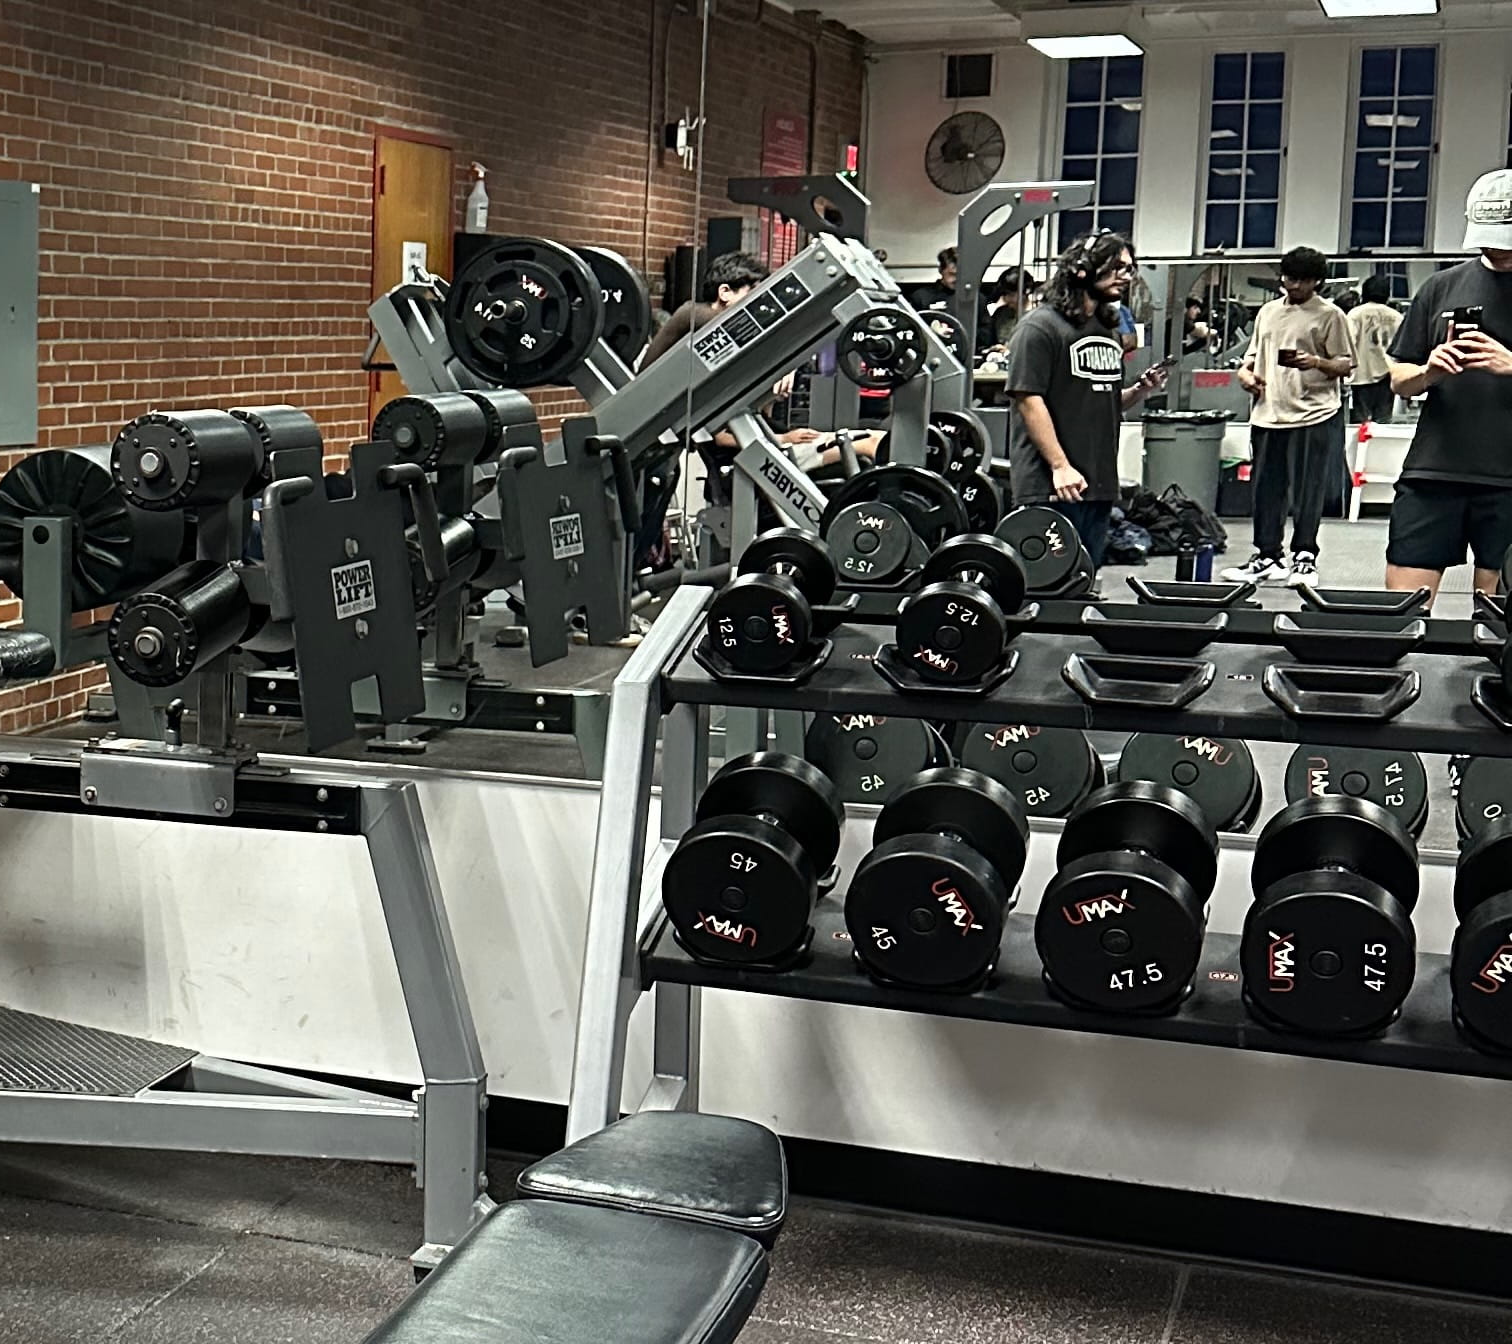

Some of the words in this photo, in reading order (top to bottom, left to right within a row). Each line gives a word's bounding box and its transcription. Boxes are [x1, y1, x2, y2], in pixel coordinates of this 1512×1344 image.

[333, 564, 371, 590] POWER
[336, 581, 373, 606] LIFT
[771, 605, 794, 645] UMAX
[944, 601, 979, 627] 12.5
[718, 616, 736, 648] 12.5
[913, 643, 959, 676] UMAX
[729, 852, 758, 874] 45
[931, 877, 984, 937] UMAX
[1062, 888, 1136, 925] UMAX
[693, 910, 757, 947] UMAX
[871, 925, 897, 950] 45
[1109, 962, 1163, 991] 47.5
[1268, 931, 1295, 992] UMAX
[1364, 943, 1387, 992] 47.5
[1472, 932, 1512, 993] UMA
